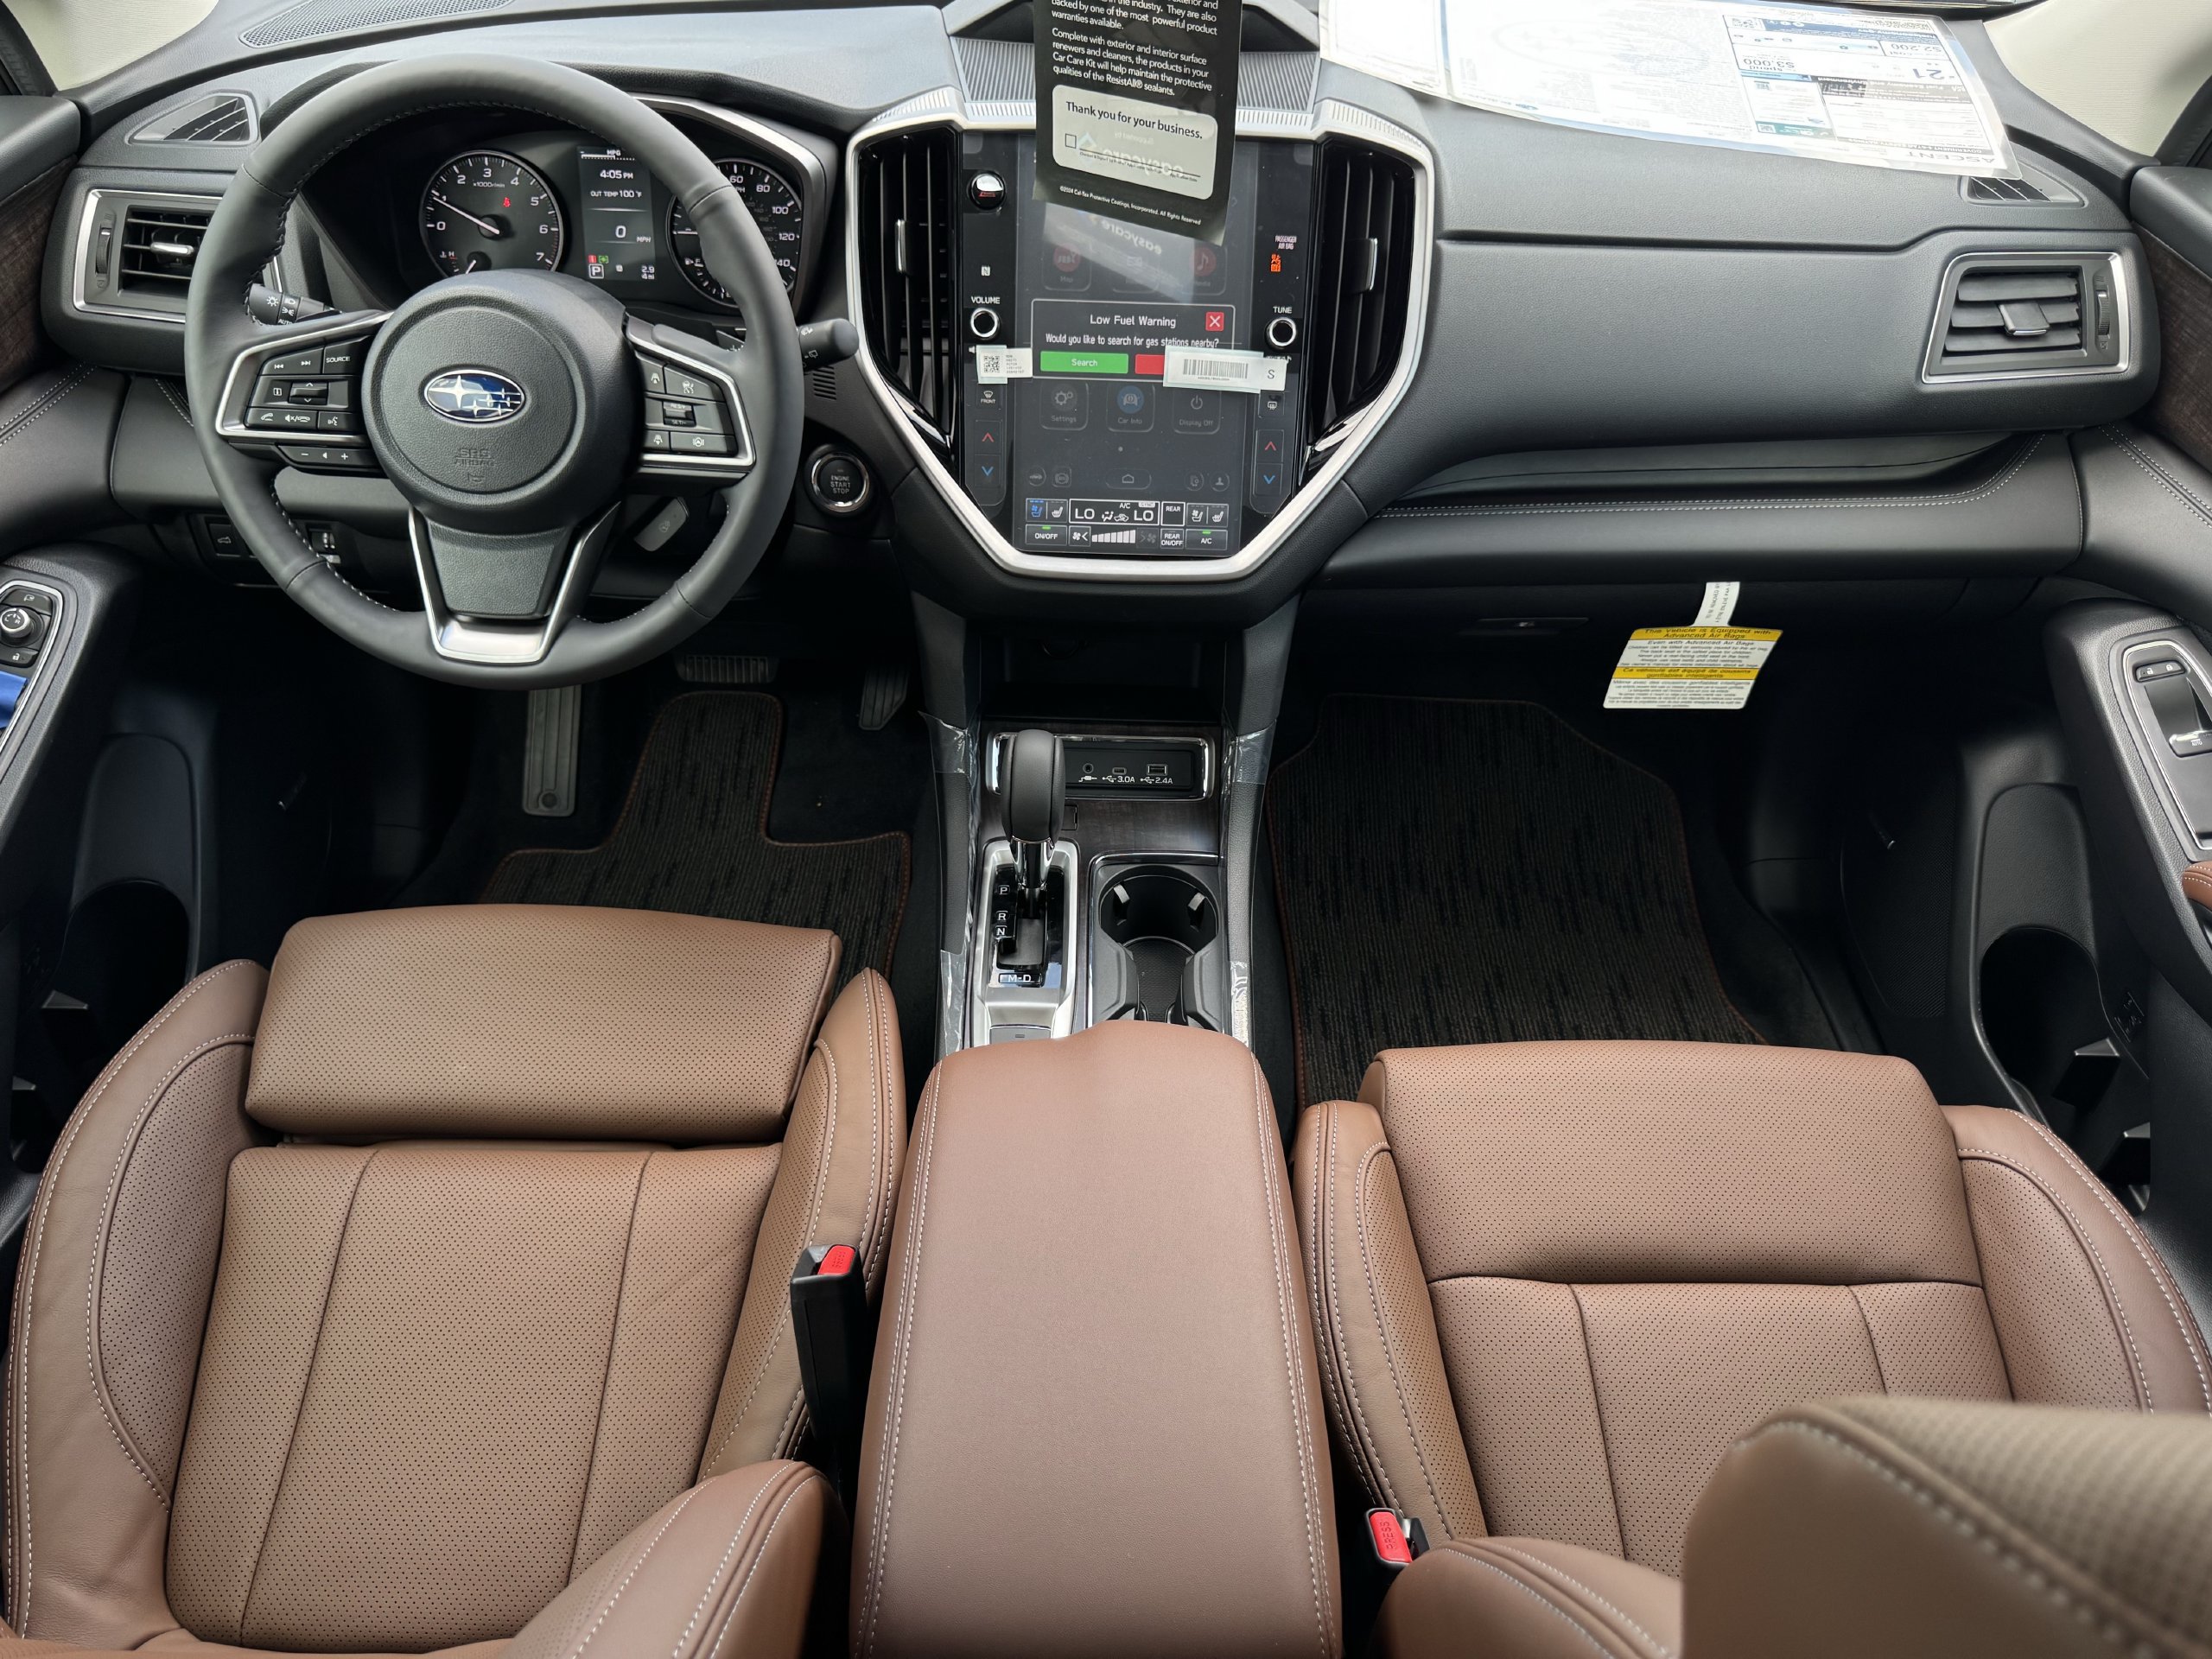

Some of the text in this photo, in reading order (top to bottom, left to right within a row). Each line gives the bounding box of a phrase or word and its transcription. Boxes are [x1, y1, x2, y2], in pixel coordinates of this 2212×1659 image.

[1203, 0, 1218, 10] and
[1131, 0, 1163, 12] industry.
[1167, 4, 1185, 18] They
[1201, 10, 1217, 22] also
[1052, 10, 1124, 29] warranties available.
[1079, 2, 1089, 13] by
[1090, 5, 1104, 14] one
[1106, 6, 1116, 16] of
[1116, 7, 1128, 18] the
[1130, 12, 1148, 22] most
[1152, 15, 1185, 29] powerful
[1186, 22, 1217, 35] product
[1052, 28, 1207, 66] Complete with exterior and interior surface
[1052, 41, 1209, 78] renewers and cleaners, the products in your
[1052, 52, 1212, 92] Car Care Kit will help maintain the protective
[1912, 68, 1944, 79] 21
[1053, 65, 1082, 79] qualities
[1084, 70, 1091, 79] of
[1092, 72, 1104, 82] the
[1144, 81, 1175, 96] sealants.
[1066, 101, 1096, 117] Thank
[1097, 110, 1115, 121] you
[1117, 111, 1132, 124] for
[1133, 117, 1155, 129] your
[1158, 119, 1203, 139] business.
[1906, 151, 1994, 163] ASCENT
[483, 168, 492, 178] 3
[600, 170, 622, 179] 4:05
[457, 175, 466, 184] 2
[511, 177, 519, 186] 4
[729, 175, 743, 184] 60
[531, 197, 539, 206] 5
[1090, 193, 1110, 203] Protective
[1167, 212, 1180, 220] Rights
[1181, 215, 1201, 225] Reserved
[436, 222, 446, 231] 0
[539, 225, 548, 233] 6
[615, 226, 626, 238] 0
[536, 252, 544, 261] 7
[592, 266, 601, 276] P
[1090, 315, 1176, 328] Low Fuel Warning
[1046, 333, 1219, 348] Would you like to search for gas stations nearby?
[1071, 359, 1098, 367] Search
[1268, 369, 1274, 379] S
[1179, 419, 1202, 428] Display
[1075, 508, 1095, 519] LO
[1134, 511, 1154, 521] LO
